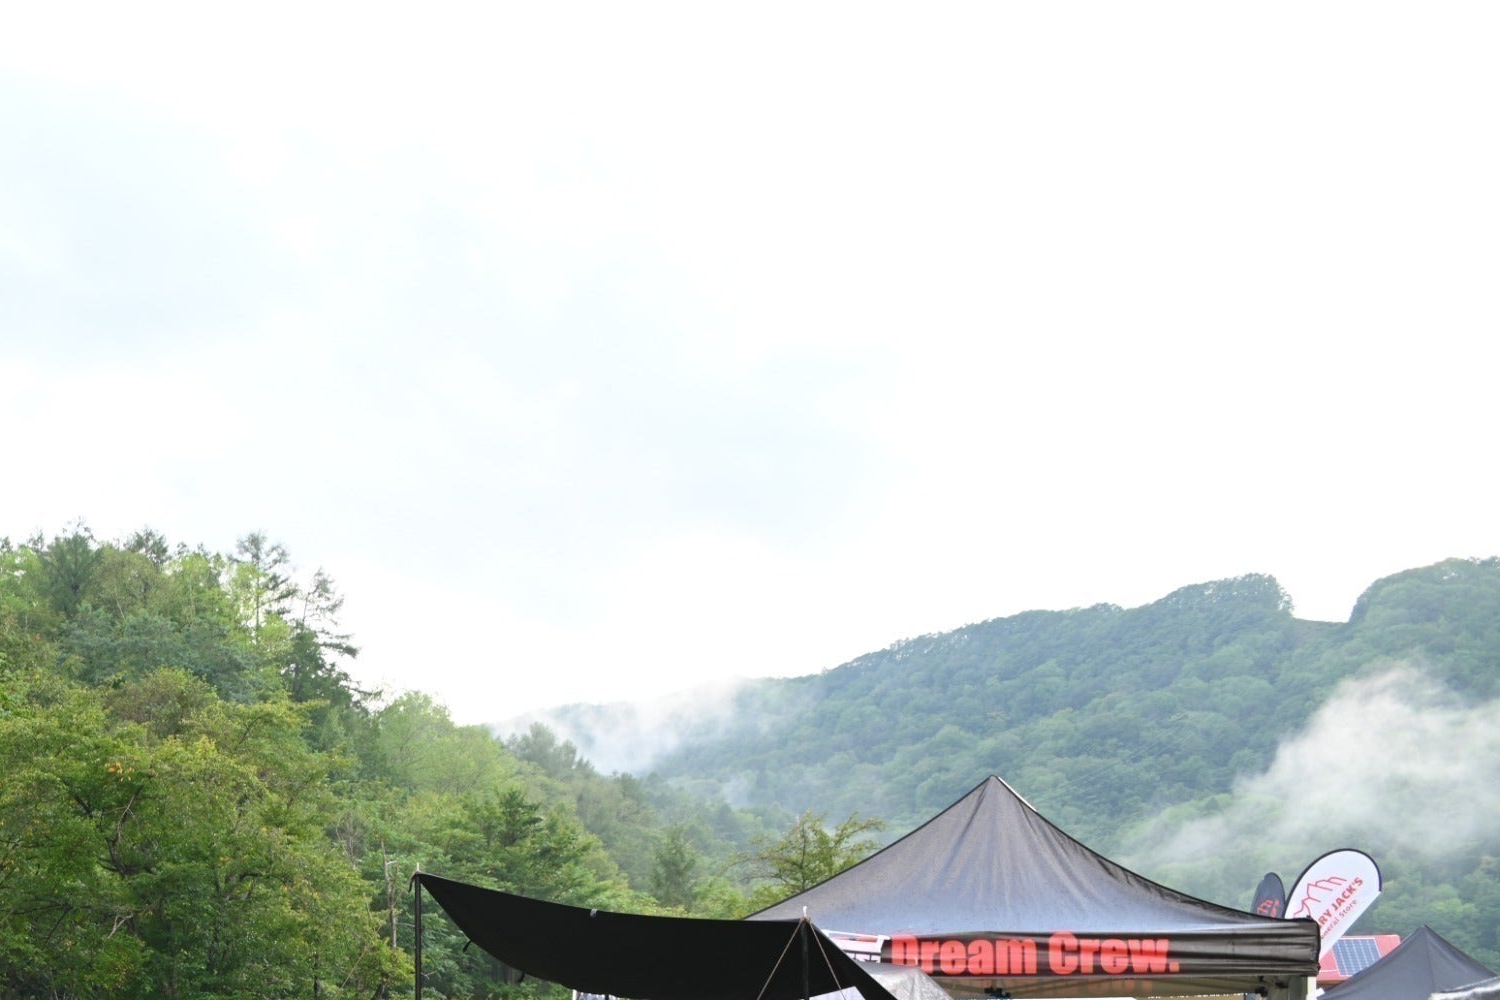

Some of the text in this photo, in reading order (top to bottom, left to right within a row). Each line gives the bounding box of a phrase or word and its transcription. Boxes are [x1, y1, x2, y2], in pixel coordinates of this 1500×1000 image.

[1331, 876, 1363, 911] JACK'S
[1320, 899, 1358, 940] eneral Store
[890, 929, 1181, 976] Dream Crew.
